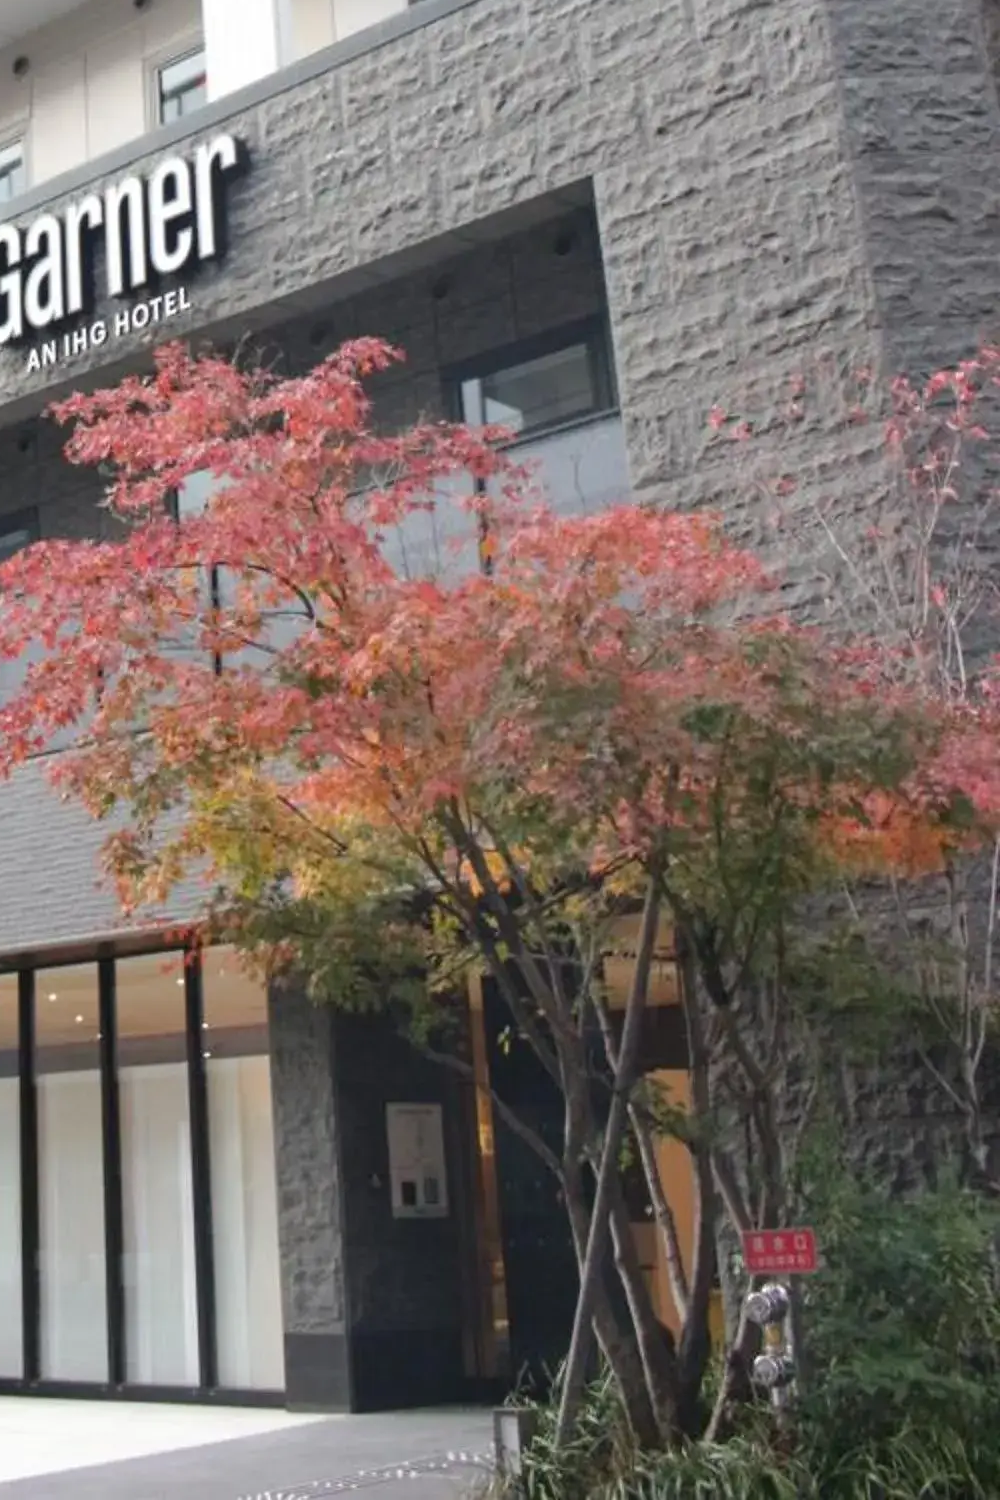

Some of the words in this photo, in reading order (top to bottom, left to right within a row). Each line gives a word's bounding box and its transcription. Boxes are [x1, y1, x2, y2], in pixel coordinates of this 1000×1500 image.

[26, 340, 57, 373] AN
[64, 320, 107, 357] IHG
[114, 286, 191, 336] HOTEL
